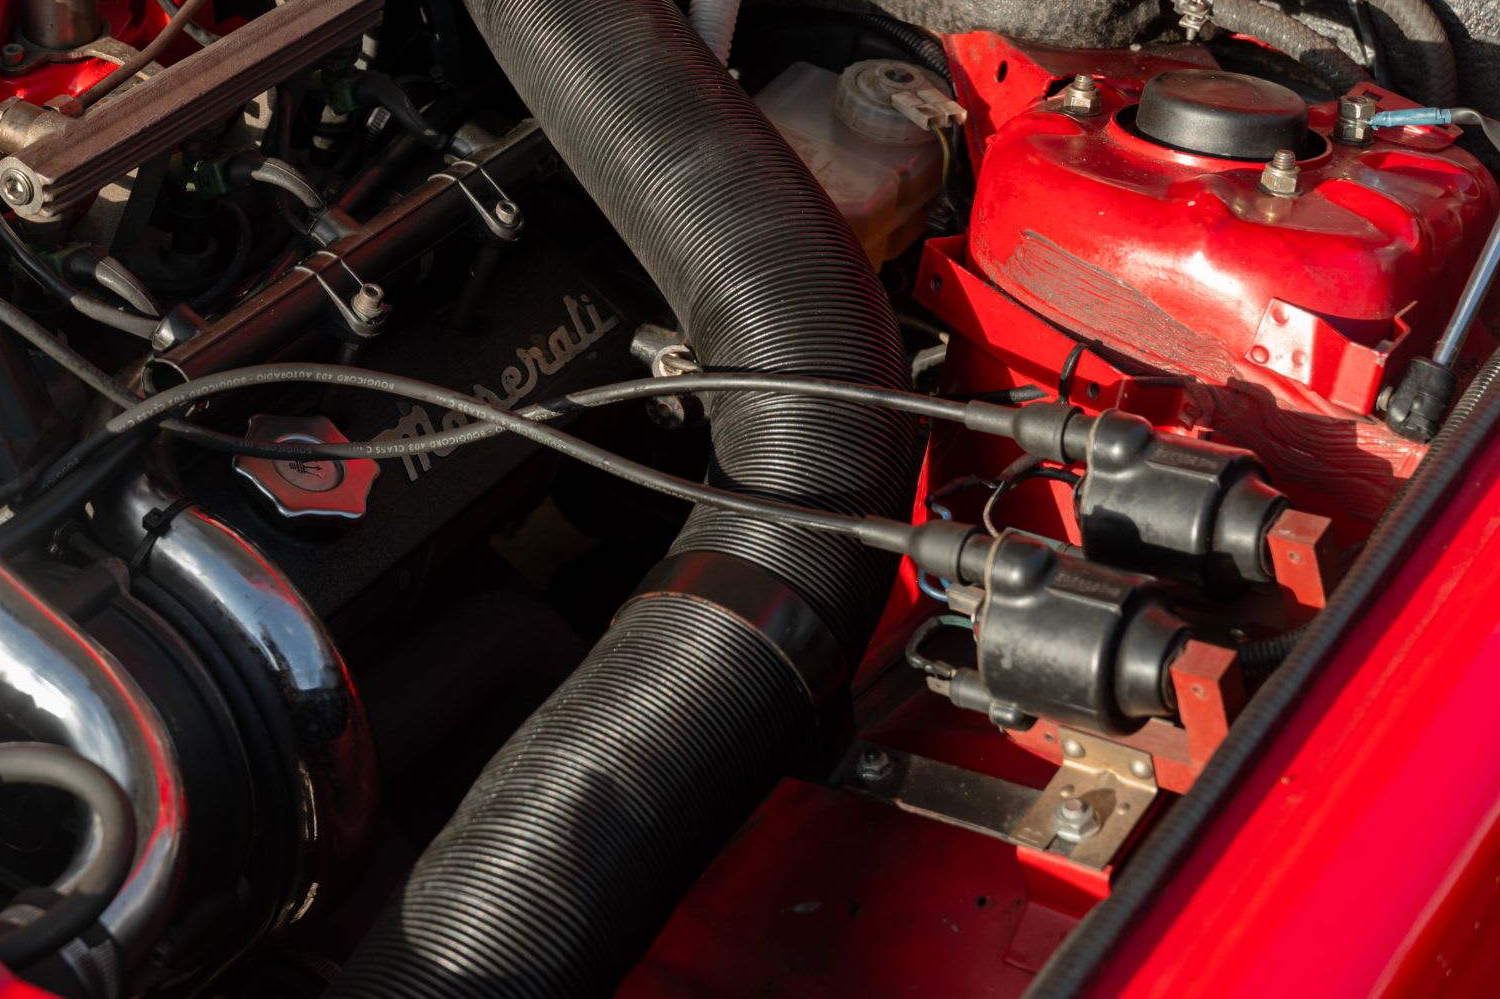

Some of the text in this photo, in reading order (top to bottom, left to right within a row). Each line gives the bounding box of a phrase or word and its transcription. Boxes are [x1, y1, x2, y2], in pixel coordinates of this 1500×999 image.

[256, 370, 312, 381] AUTORADIO
[315, 372, 333, 381] 403
[189, 376, 246, 397] BOUGICORD
[337, 374, 395, 390] BOUGICORD
[429, 430, 486, 447] BOUGICORD
[375, 444, 405, 454] CLASS
[408, 442, 426, 453] 403
